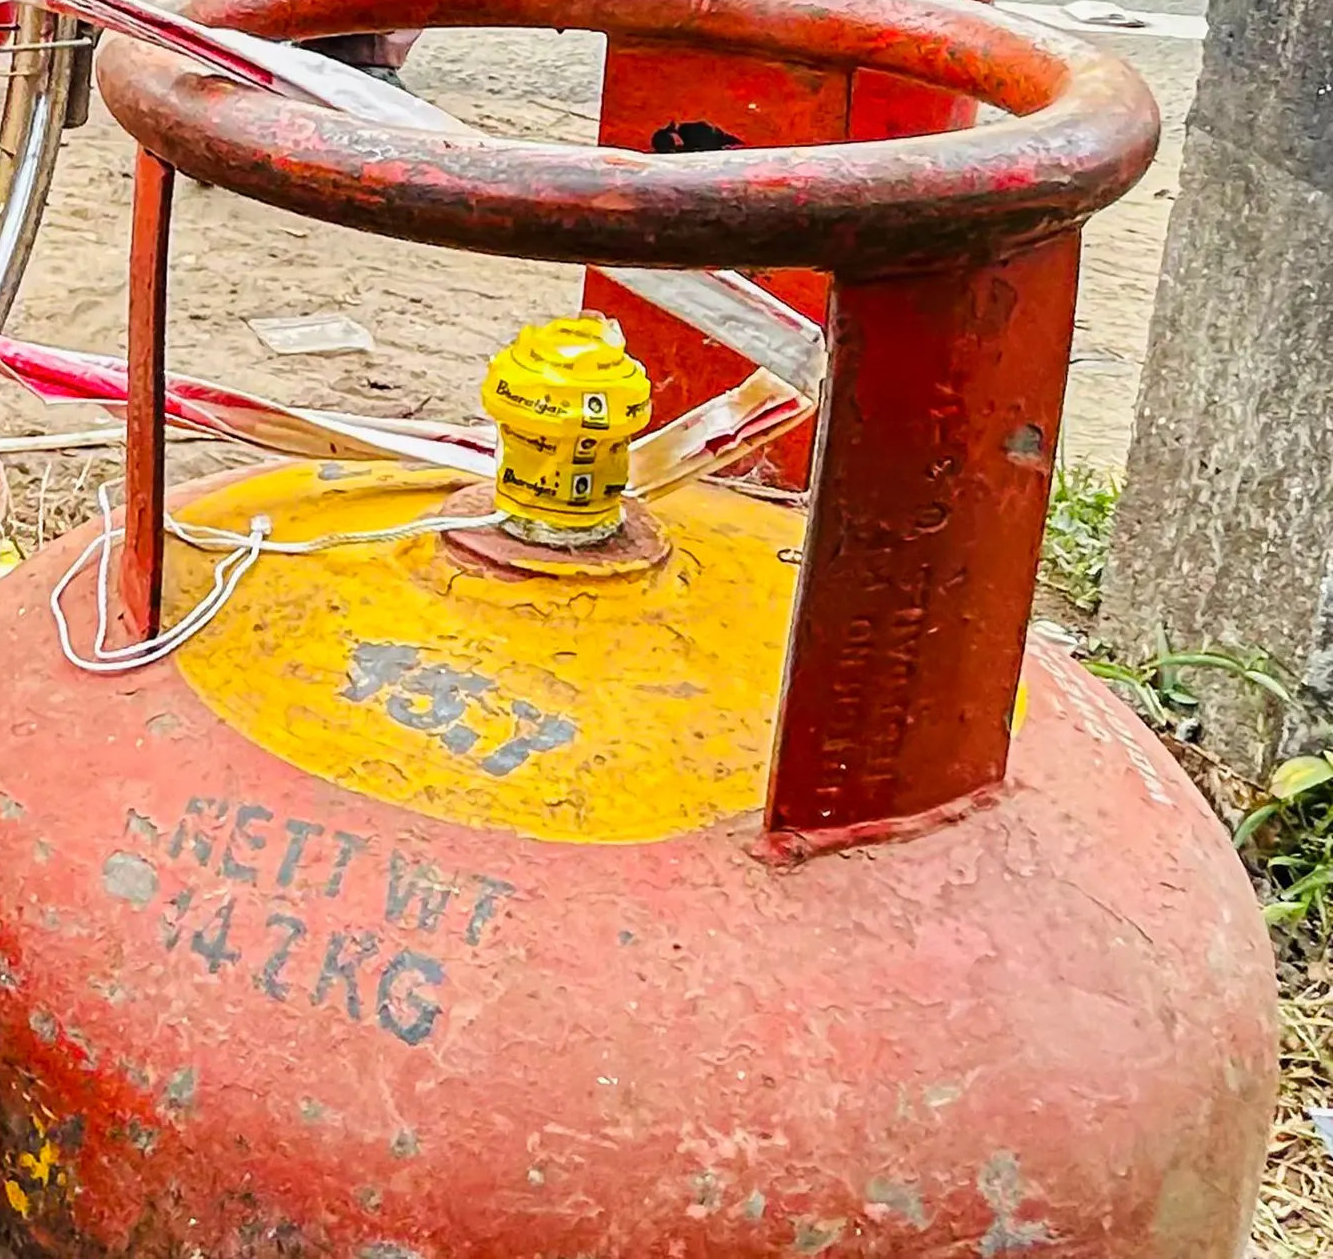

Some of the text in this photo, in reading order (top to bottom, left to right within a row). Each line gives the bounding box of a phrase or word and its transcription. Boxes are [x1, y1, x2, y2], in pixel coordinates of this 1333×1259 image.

[335, 641, 577, 777] 15.7
[166, 797, 516, 946] NETT WT
[310, 930, 448, 1045] KG
